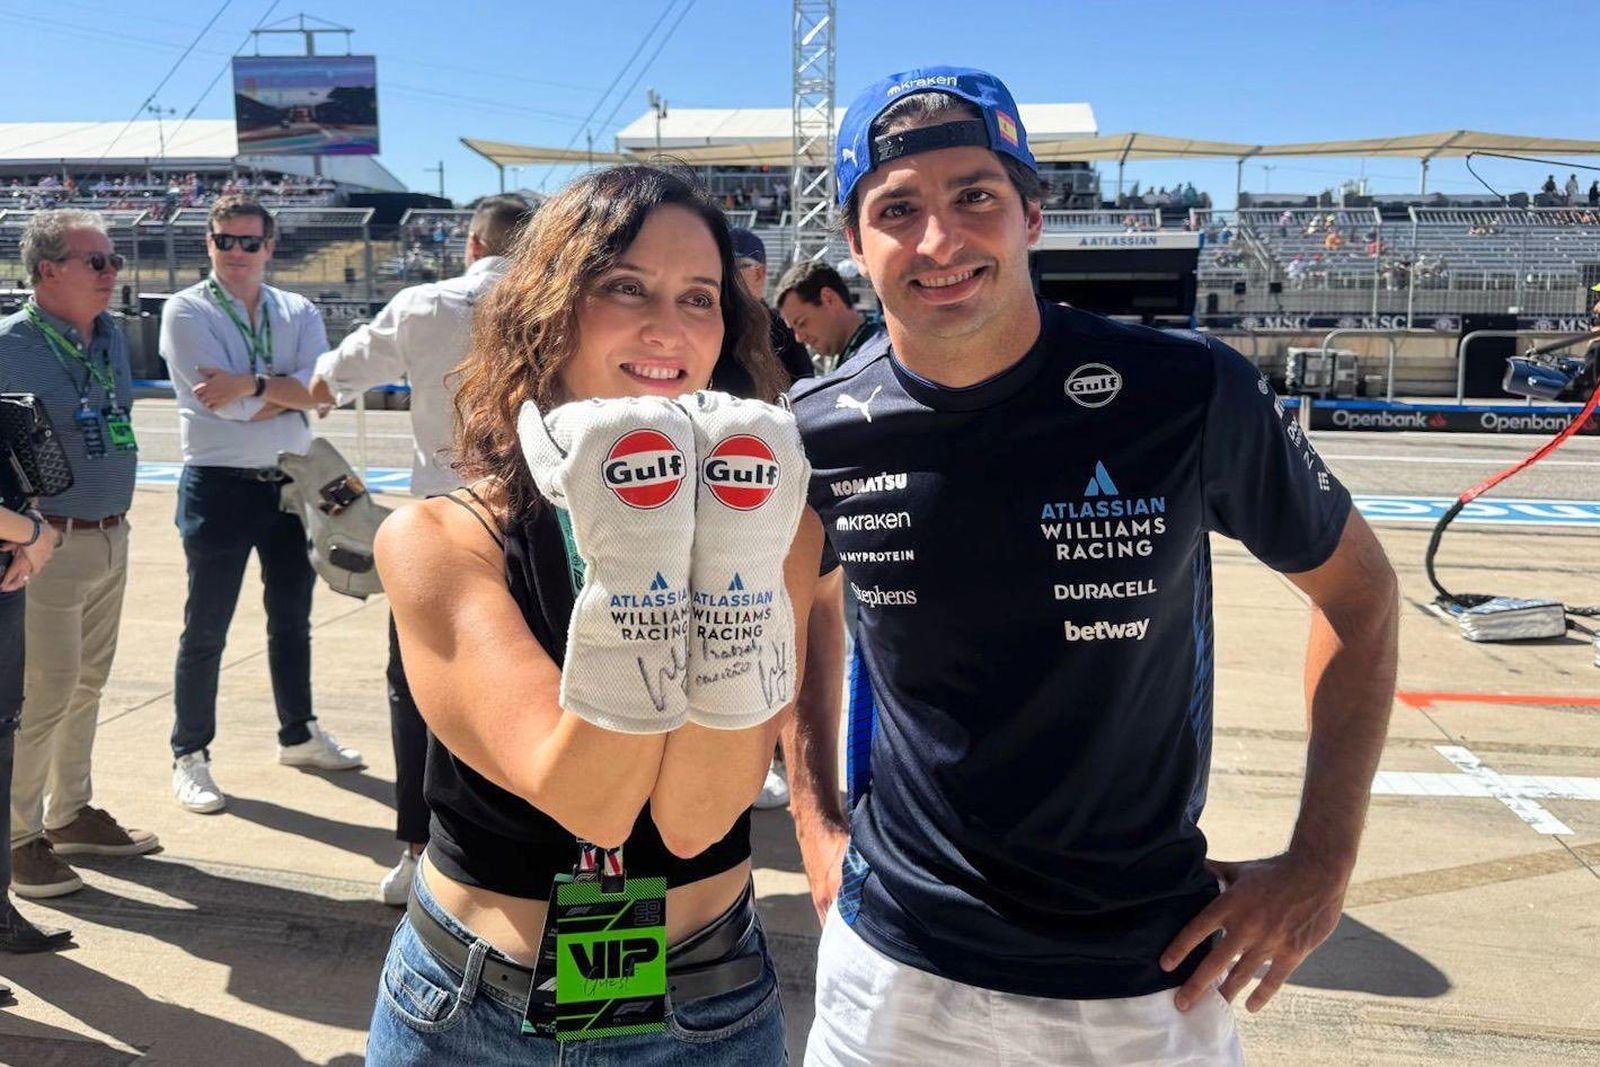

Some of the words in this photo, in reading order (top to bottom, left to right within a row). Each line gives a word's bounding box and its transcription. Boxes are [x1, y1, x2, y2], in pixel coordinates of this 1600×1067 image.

[1091, 237, 1157, 246] ATLASSIAN
[1559, 317, 1592, 331] MS
[1069, 376, 1117, 392] Gulf
[1332, 409, 1427, 428] Openbank
[606, 455, 681, 484] Gulf
[706, 459, 778, 485] Gulf
[830, 472, 908, 497] KOMATSU
[1041, 497, 1166, 519] ATLASSIAN
[849, 511, 911, 531] kraken
[1040, 517, 1166, 540] WILLIAMS
[847, 549, 915, 562] MYPROTEIN
[1056, 540, 1153, 560] RACING
[693, 590, 773, 608] ATLASSIAN
[850, 581, 917, 608] Stephens
[1054, 579, 1157, 600] DURACELL
[692, 606, 772, 626] WILLIAMS
[697, 624, 763, 641] RACING
[1064, 618, 1150, 641] betway
[568, 938, 660, 980] VIP
